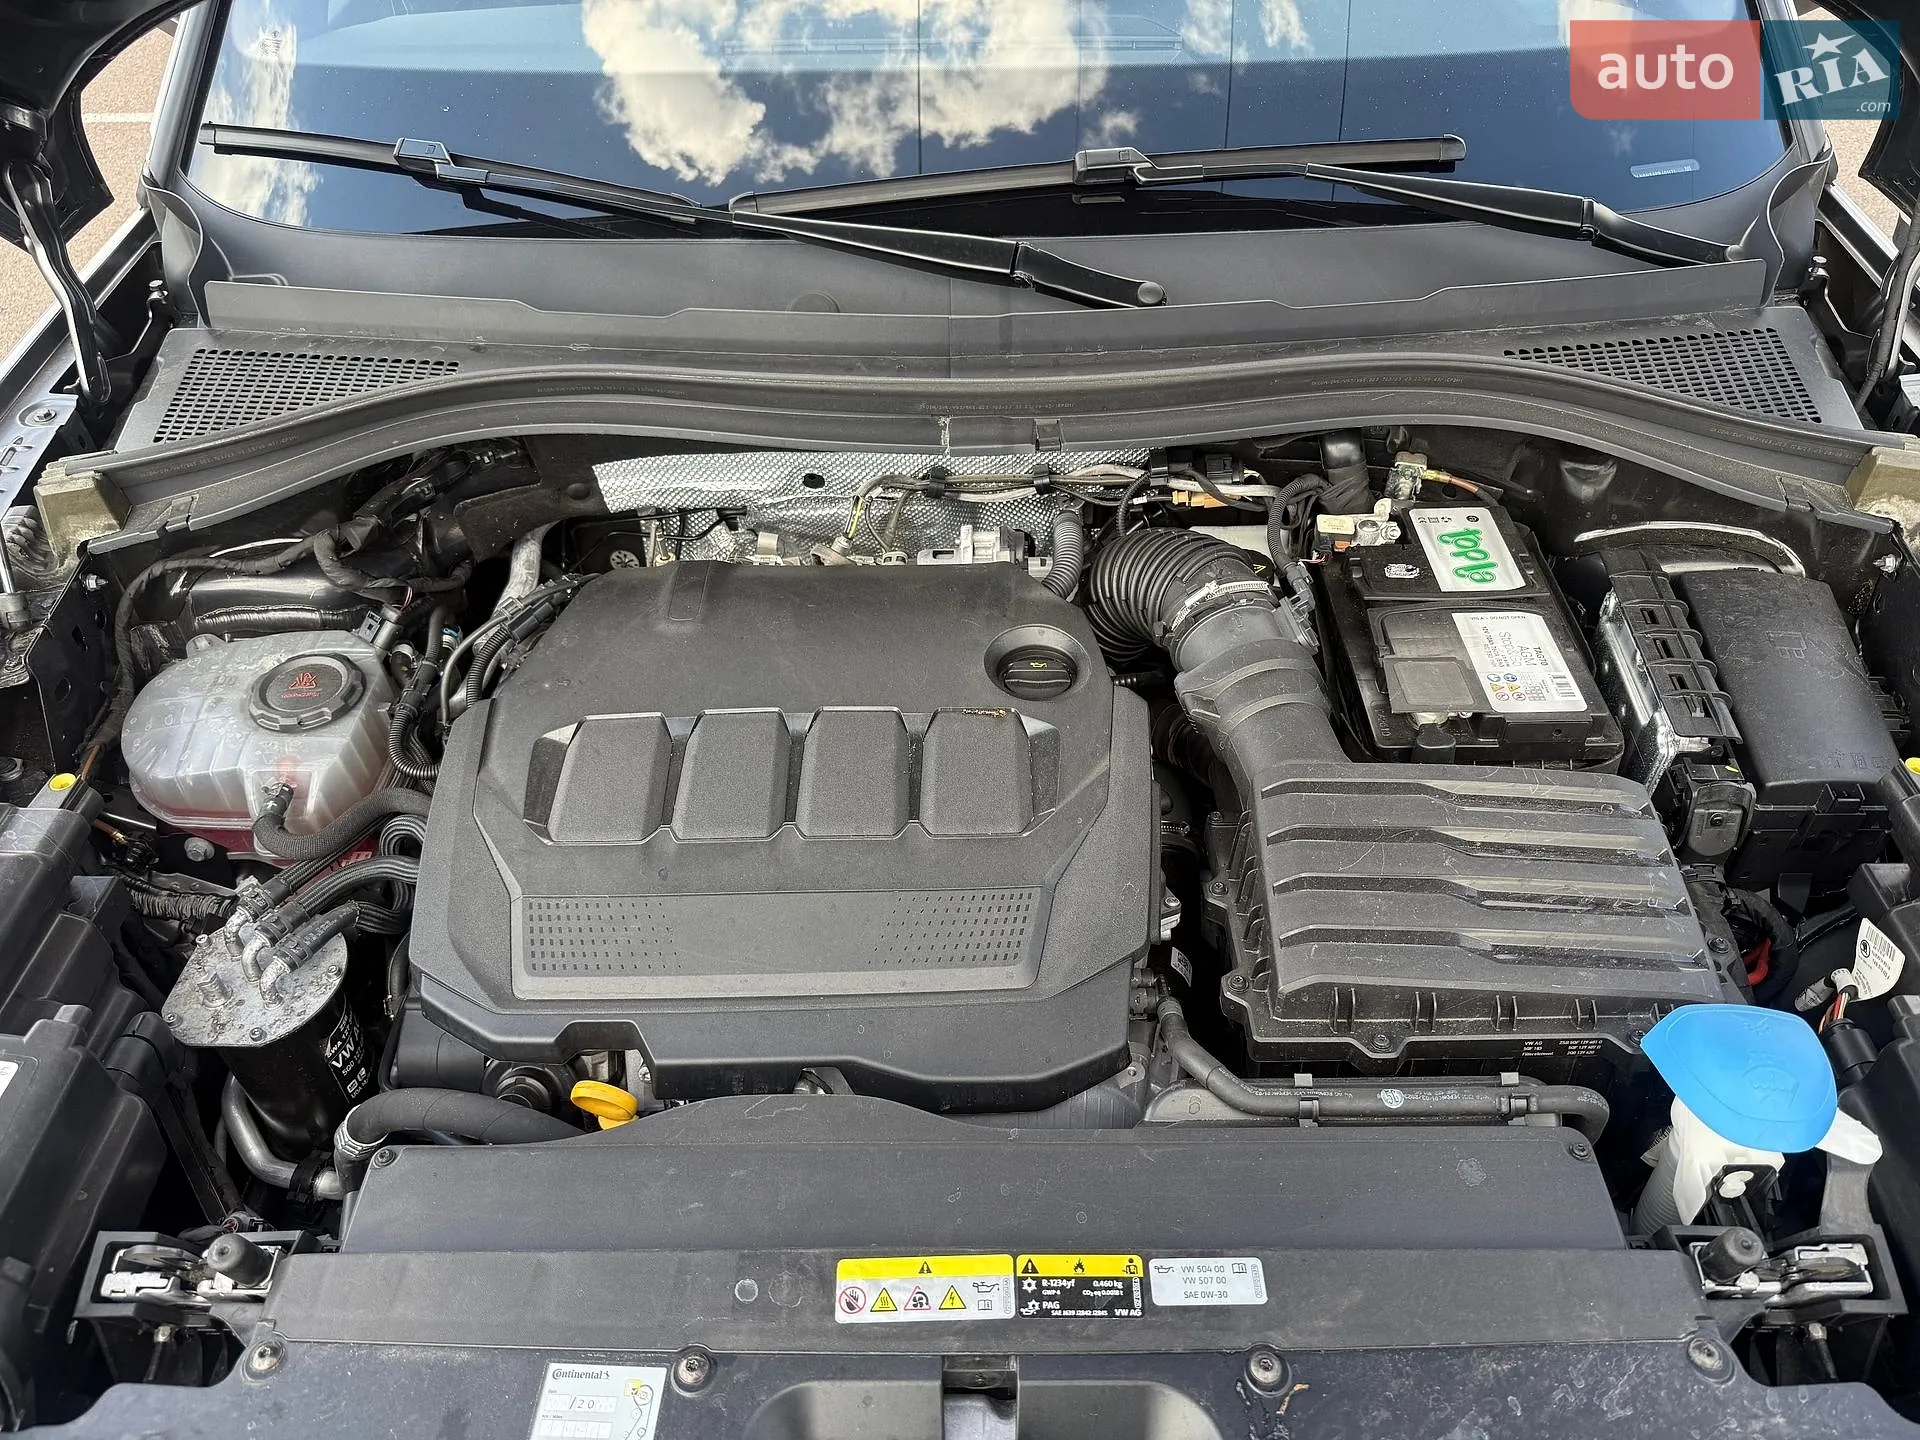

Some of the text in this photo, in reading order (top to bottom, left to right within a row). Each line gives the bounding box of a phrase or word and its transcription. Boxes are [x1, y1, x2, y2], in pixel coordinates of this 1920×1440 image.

[1517, 645, 1537, 666] AGM
[1533, 646, 1549, 666] TAG70
[331, 1037, 355, 1068] VW
[1181, 1265, 1226, 1273] VW 504 00
[1042, 1278, 1076, 1289] R-1234yf
[1114, 1280, 1123, 1289] kg
[1182, 1276, 1227, 1284] VW 507 00
[1183, 1290, 1229, 1298] SAE 0W-30
[1042, 1301, 1060, 1310] PAG
[552, 1368, 603, 1380] Continental
